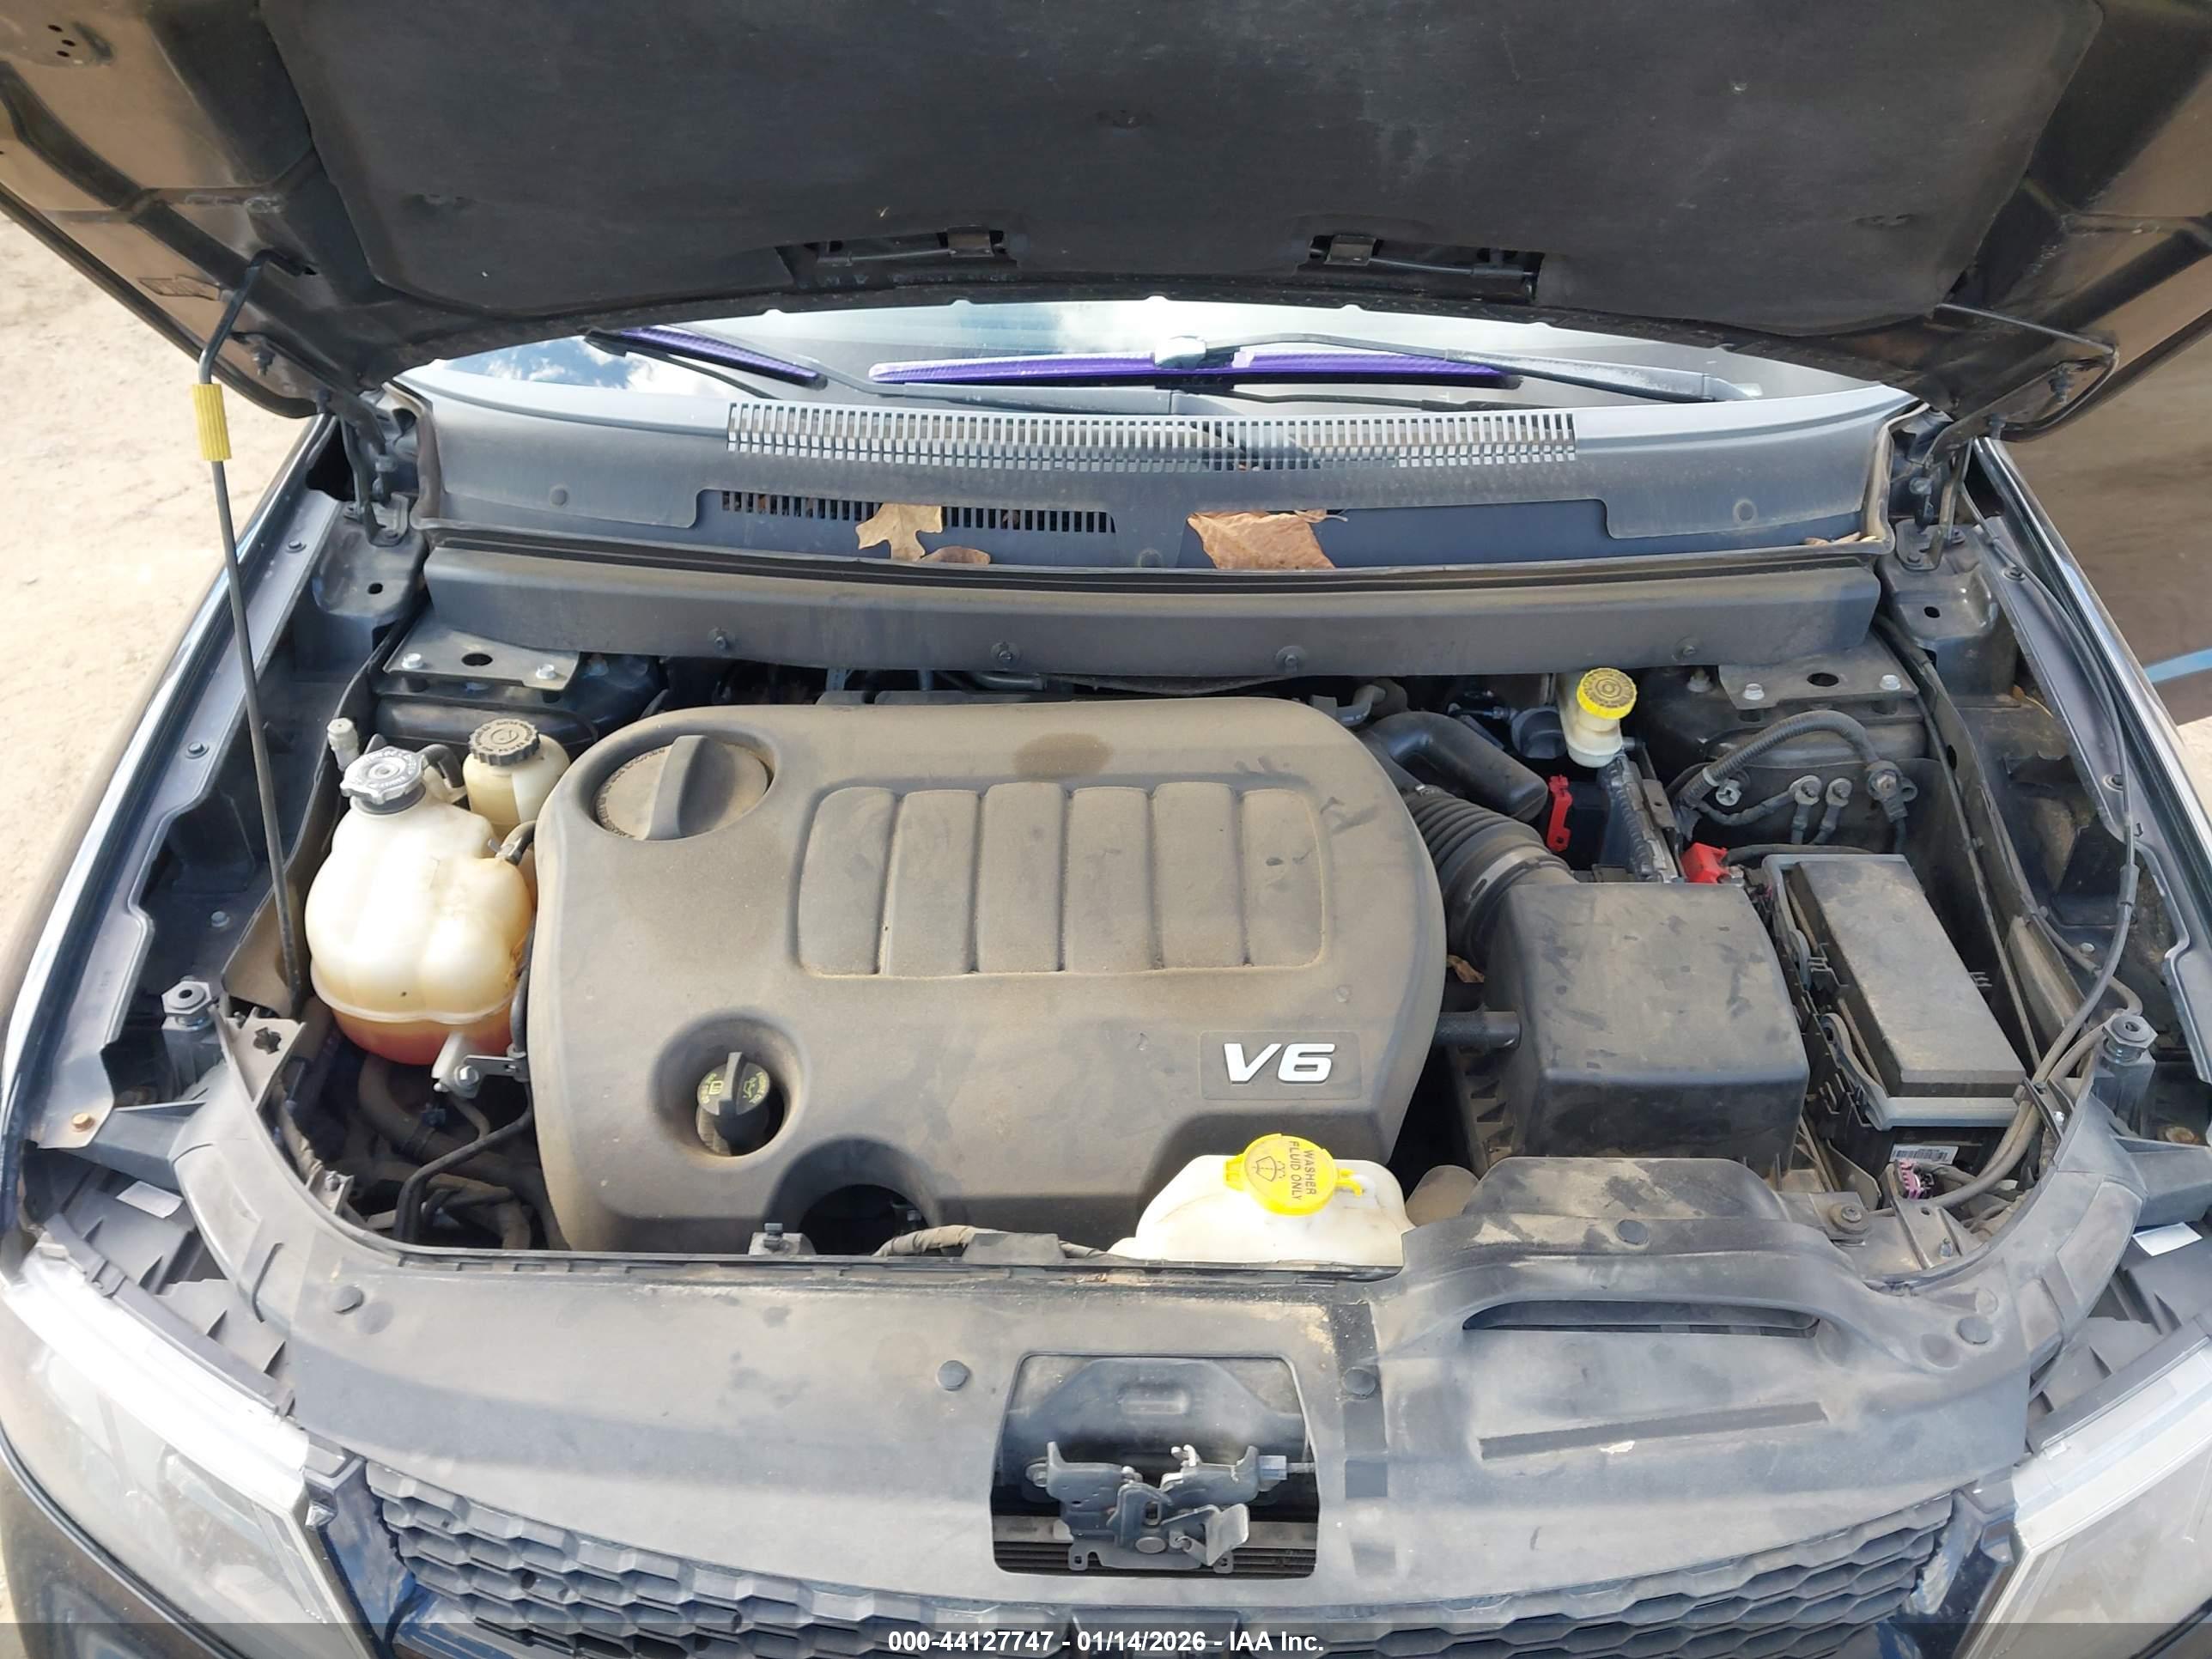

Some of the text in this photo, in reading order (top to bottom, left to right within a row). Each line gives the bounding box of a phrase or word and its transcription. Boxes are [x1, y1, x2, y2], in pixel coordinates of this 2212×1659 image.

[1224, 1042, 1336, 1084] V6
[1289, 1140, 1303, 1200] FLUID ONLY
[1304, 1149, 1317, 1195] WASHER
